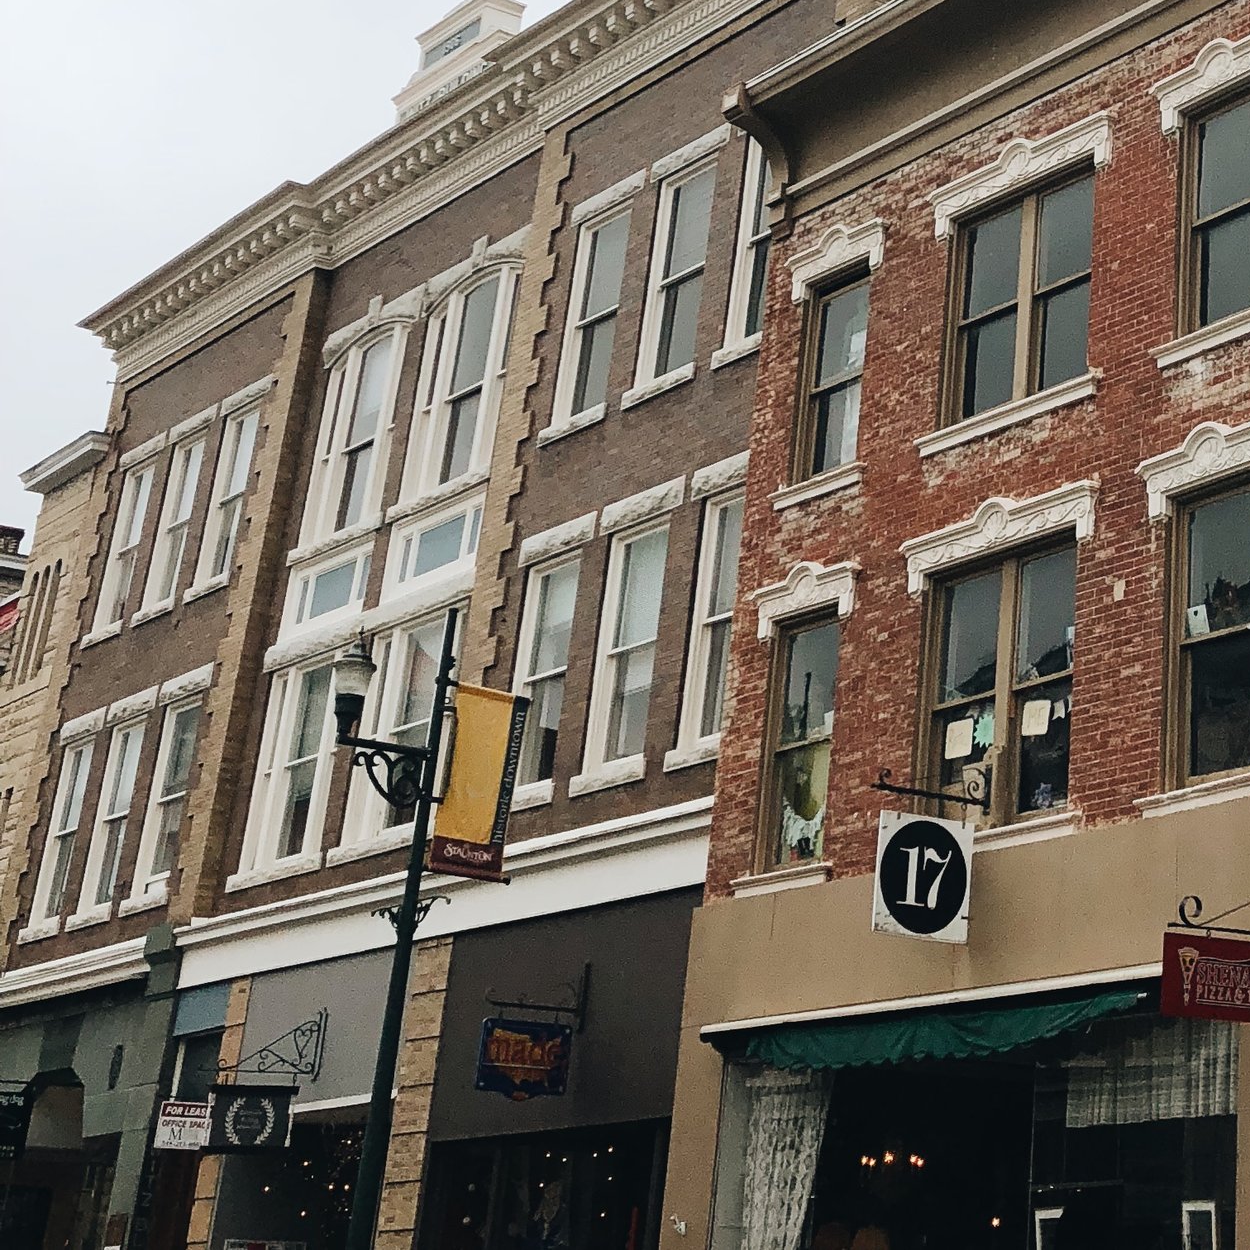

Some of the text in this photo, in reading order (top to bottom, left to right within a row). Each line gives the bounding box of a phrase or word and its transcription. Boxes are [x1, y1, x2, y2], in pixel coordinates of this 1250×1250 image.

[492, 711, 526, 844] historic downtown
[896, 846, 952, 910] 17
[1196, 984, 1232, 1001] PIZZA
[165, 1106, 209, 1117] FOR LEAS
[162, 1119, 187, 1128] OFFICE
